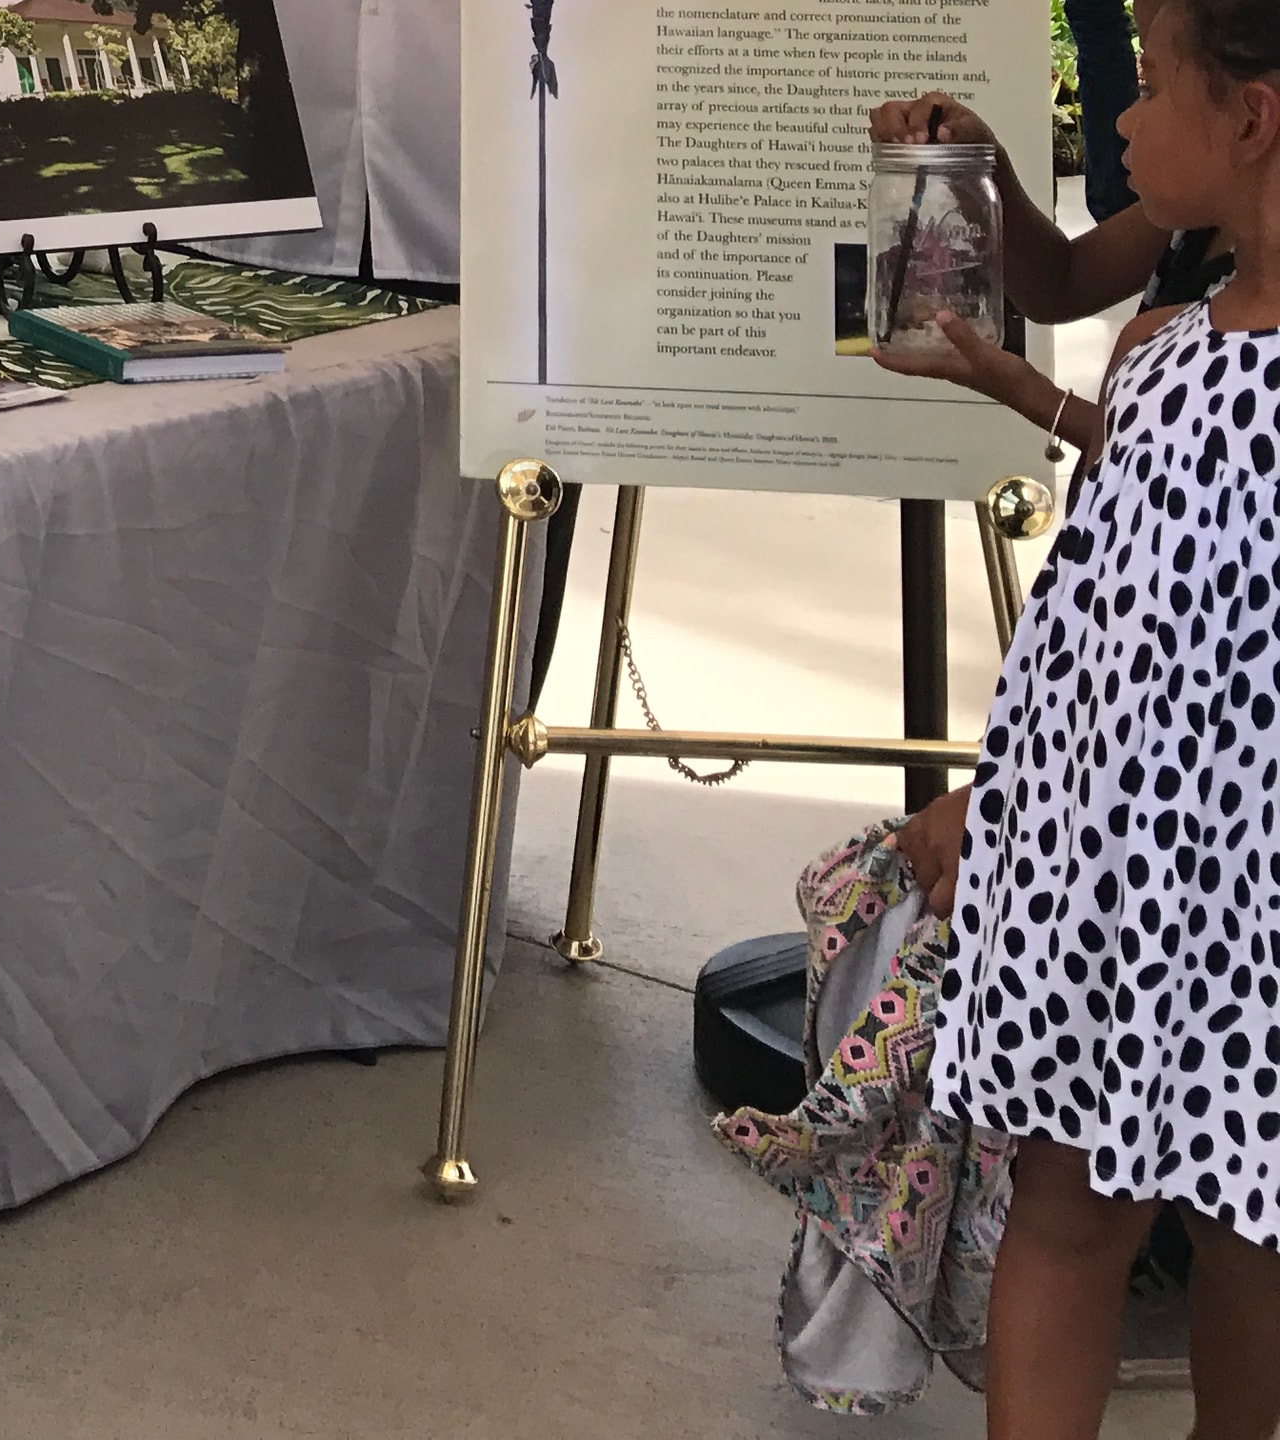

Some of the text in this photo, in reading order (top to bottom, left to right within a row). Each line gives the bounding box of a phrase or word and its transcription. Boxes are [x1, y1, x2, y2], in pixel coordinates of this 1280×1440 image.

[656, 7, 962, 26] the nomenclature and correct pronunciation of the
[656, 25, 715, 38] Hawaiian
[783, 28, 811, 40] The
[812, 30, 890, 44] organization
[891, 32, 968, 43] commenced
[656, 44, 968, 63] their efforts at a time when few people in the islands
[656, 64, 991, 84] recognized the importance of historic preservation and,
[656, 120, 869, 137] may experience the beautiful cultur
[656, 136, 683, 147] The
[684, 137, 748, 152] Daughters
[749, 139, 766, 150] of
[818, 141, 854, 152] house
[766, 177, 812, 191] (Queen
[815, 178, 857, 191] Emma
[656, 192, 681, 204] also
[682, 195, 695, 204] at
[753, 195, 792, 207] Palace
[794, 197, 808, 208] in
[810, 194, 868, 212] Kailua-K
[707, 212, 745, 224] These
[747, 217, 803, 226] museums
[804, 216, 837, 227] stand
[839, 220, 853, 228] as
[656, 230, 671, 240] of
[673, 230, 694, 241] the
[765, 233, 812, 246] mission
[656, 248, 810, 266] and of the importance of
[656, 267, 794, 282] its continuation. Please
[656, 286, 776, 303] consider joining the
[656, 307, 801, 323] organization so that you
[656, 323, 767, 339] can be part of this
[656, 342, 777, 357] important endeavor.
